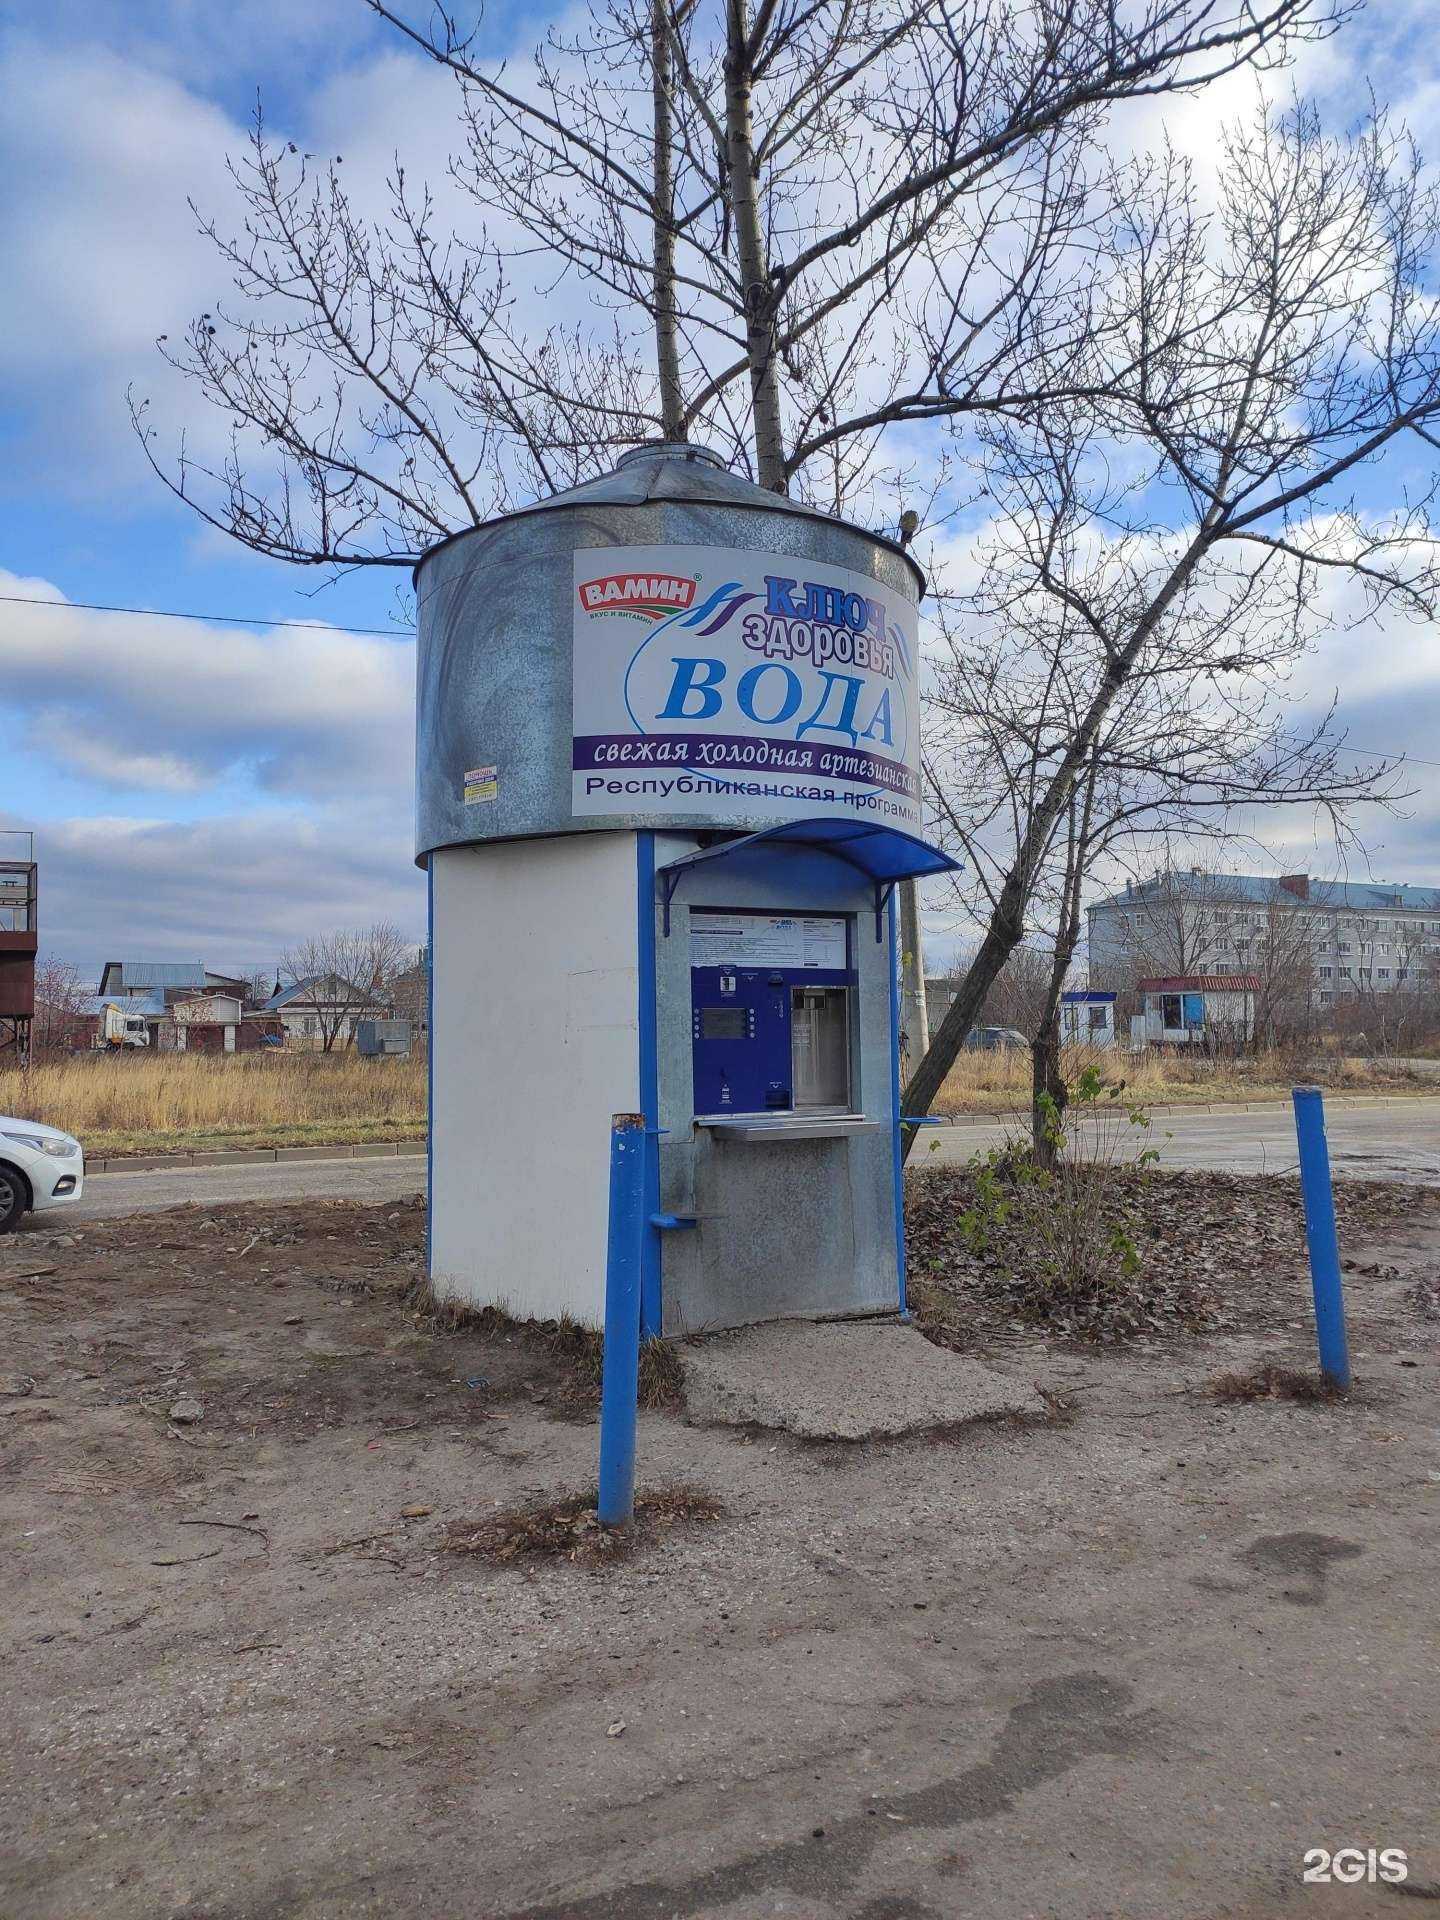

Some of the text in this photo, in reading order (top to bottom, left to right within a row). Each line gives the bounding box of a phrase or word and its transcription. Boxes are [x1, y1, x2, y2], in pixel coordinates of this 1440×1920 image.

[585, 579, 690, 605] ВАМИН
[764, 575, 886, 642] КЛЮЧ
[655, 658, 894, 747] ВОДА
[594, 741, 688, 762] свежая
[695, 740, 813, 768] холодная
[586, 776, 835, 802] Республиканская
